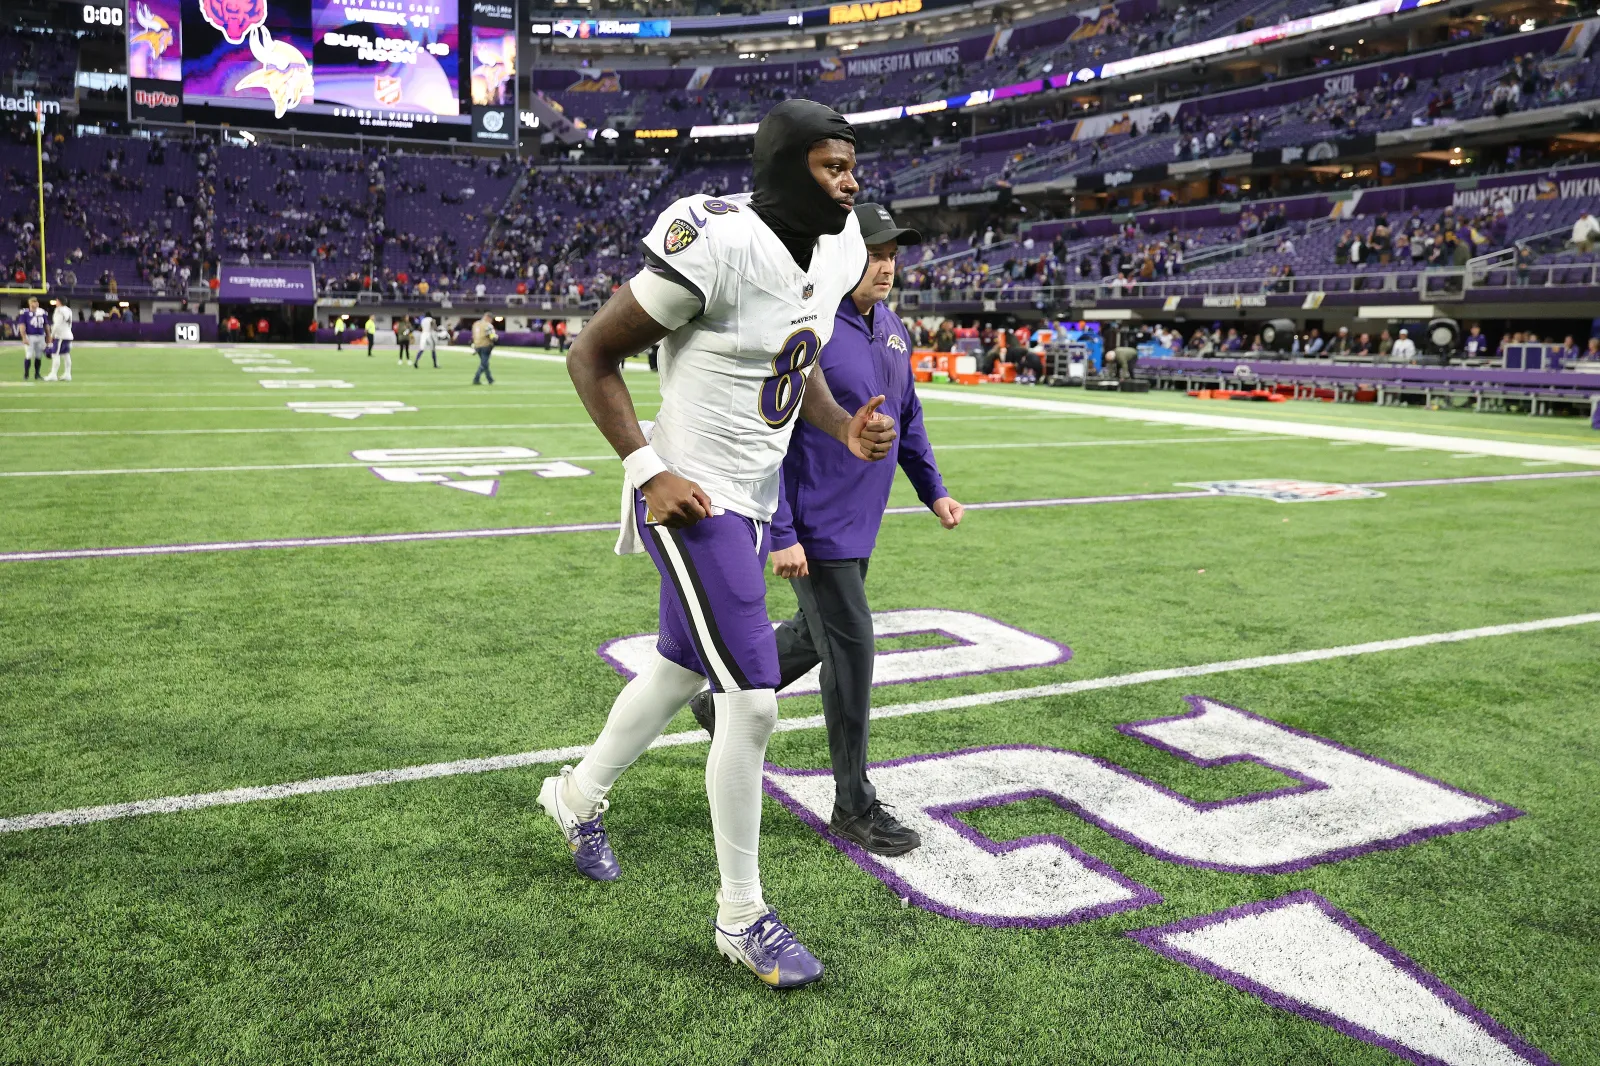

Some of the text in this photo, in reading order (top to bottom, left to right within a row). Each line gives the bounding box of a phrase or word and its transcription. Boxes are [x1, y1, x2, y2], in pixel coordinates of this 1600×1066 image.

[83, 4, 123, 26] 0:00
[344, 7, 429, 28] WEEK 11
[829, 0, 922, 25] RAVENS
[358, 47, 417, 64] NOON
[848, 47, 960, 76] MINNESOTA VIKINGS
[1324, 74, 1357, 97] SKOL
[333, 107, 438, 124] BEARS VIKINGS
[675, 219, 697, 237] RAVENS
[790, 314, 818, 325] RAVENS
[177, 326, 197, 341] 40
[758, 327, 821, 429] 8
